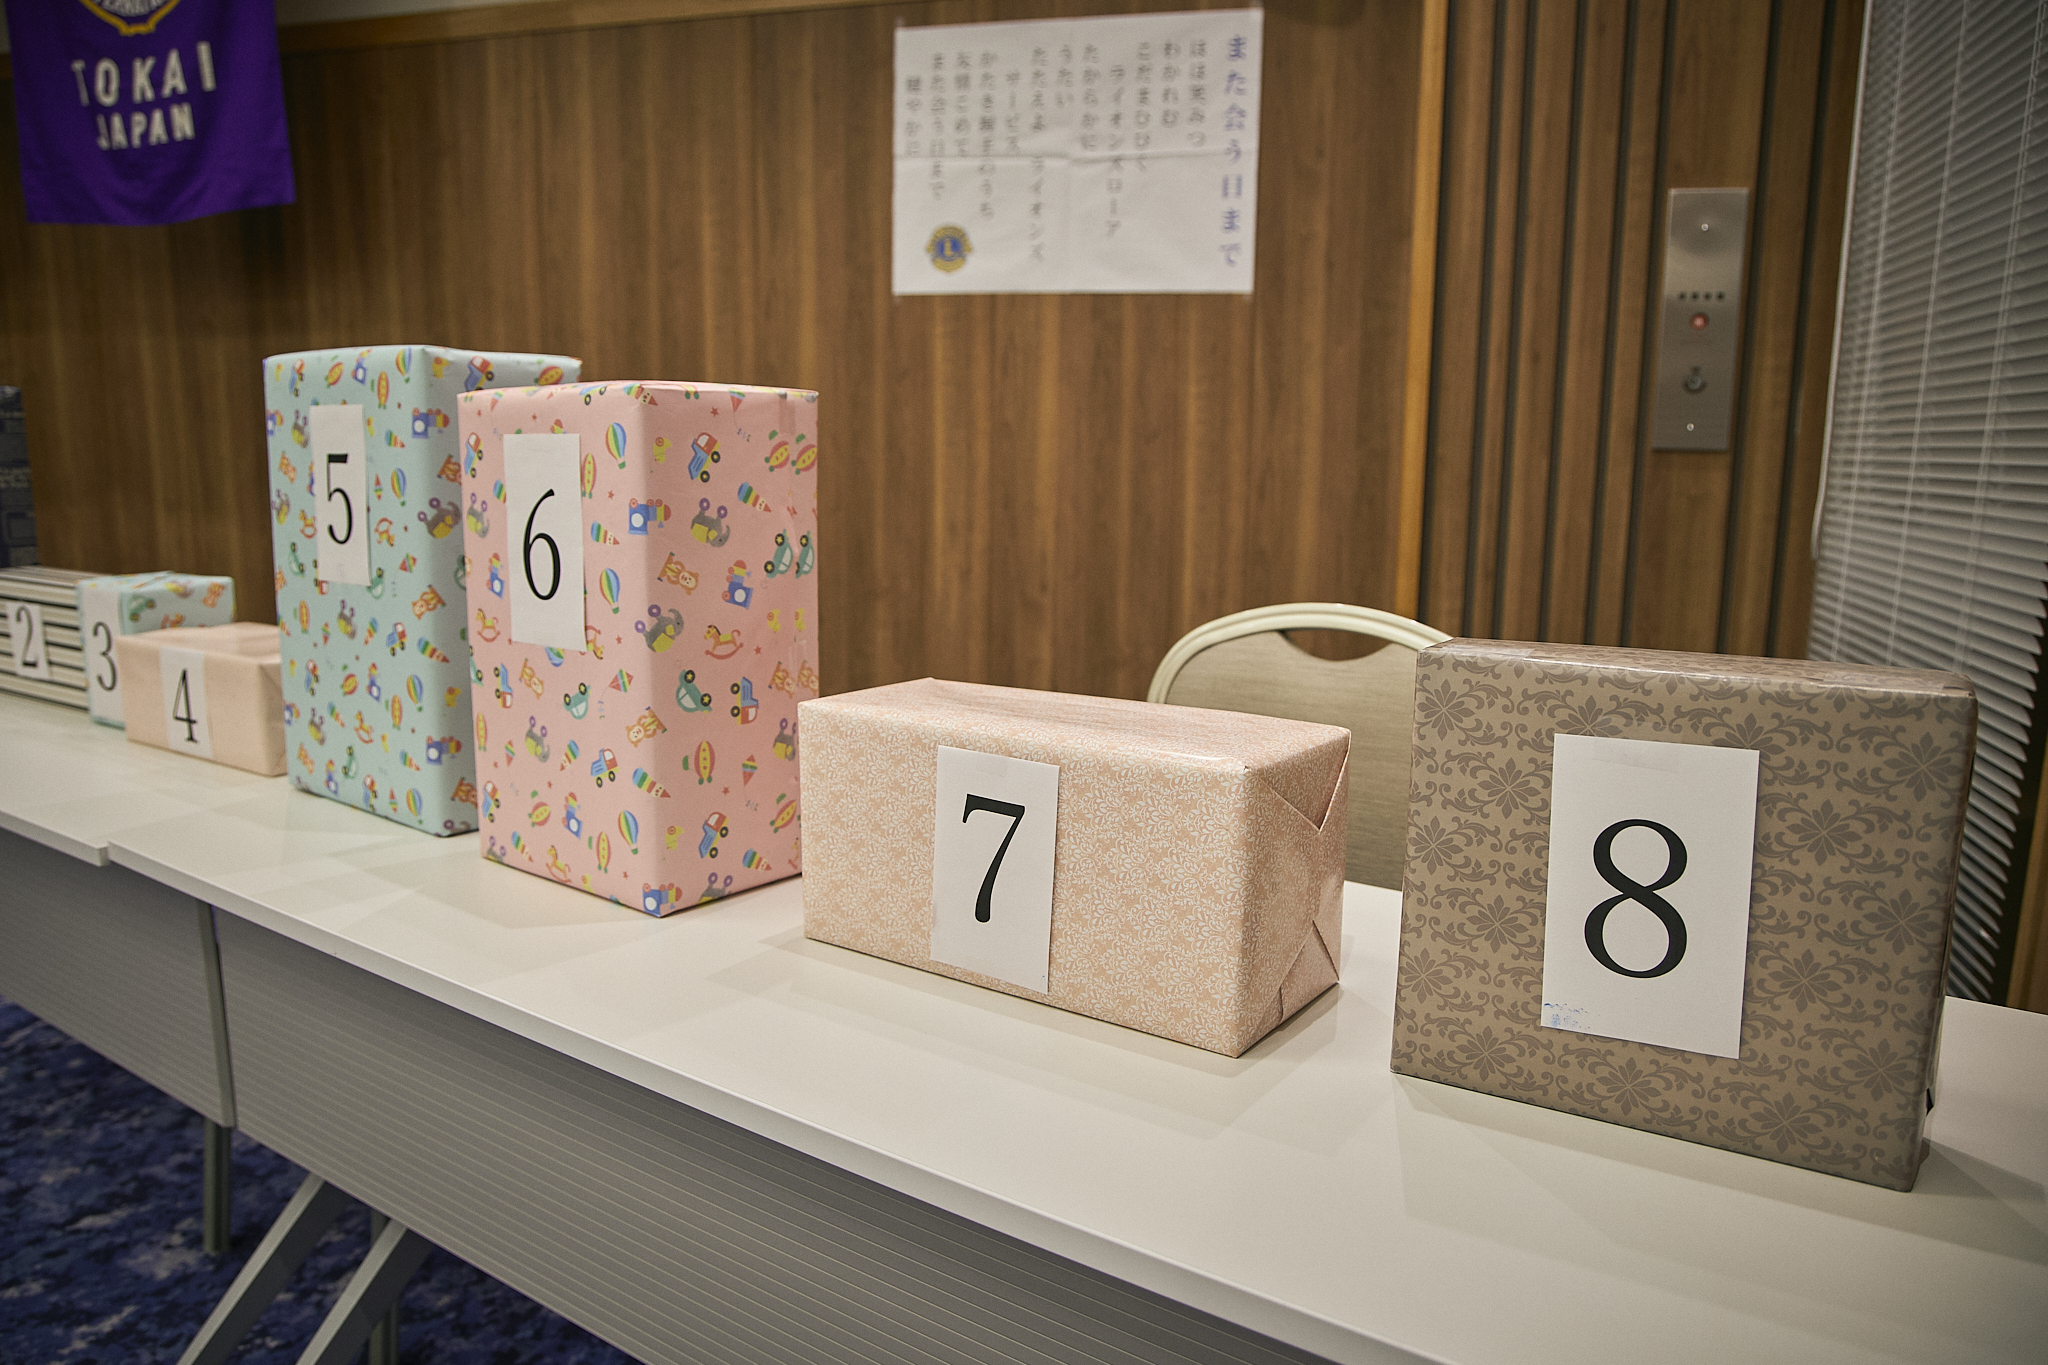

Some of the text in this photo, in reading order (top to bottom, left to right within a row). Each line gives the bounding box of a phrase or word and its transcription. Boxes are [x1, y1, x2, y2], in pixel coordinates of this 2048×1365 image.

[70, 41, 217, 108] TOKAI
[96, 102, 196, 151] JAPAN
[1219, 34, 1247, 267] また会う日まで
[325, 453, 353, 546] 5
[522, 488, 562, 602] 6
[16, 605, 38, 668] 2
[92, 621, 118, 691] 3
[172, 668, 199, 743] 4
[962, 793, 1026, 923] 7
[1583, 818, 1689, 979] 8
